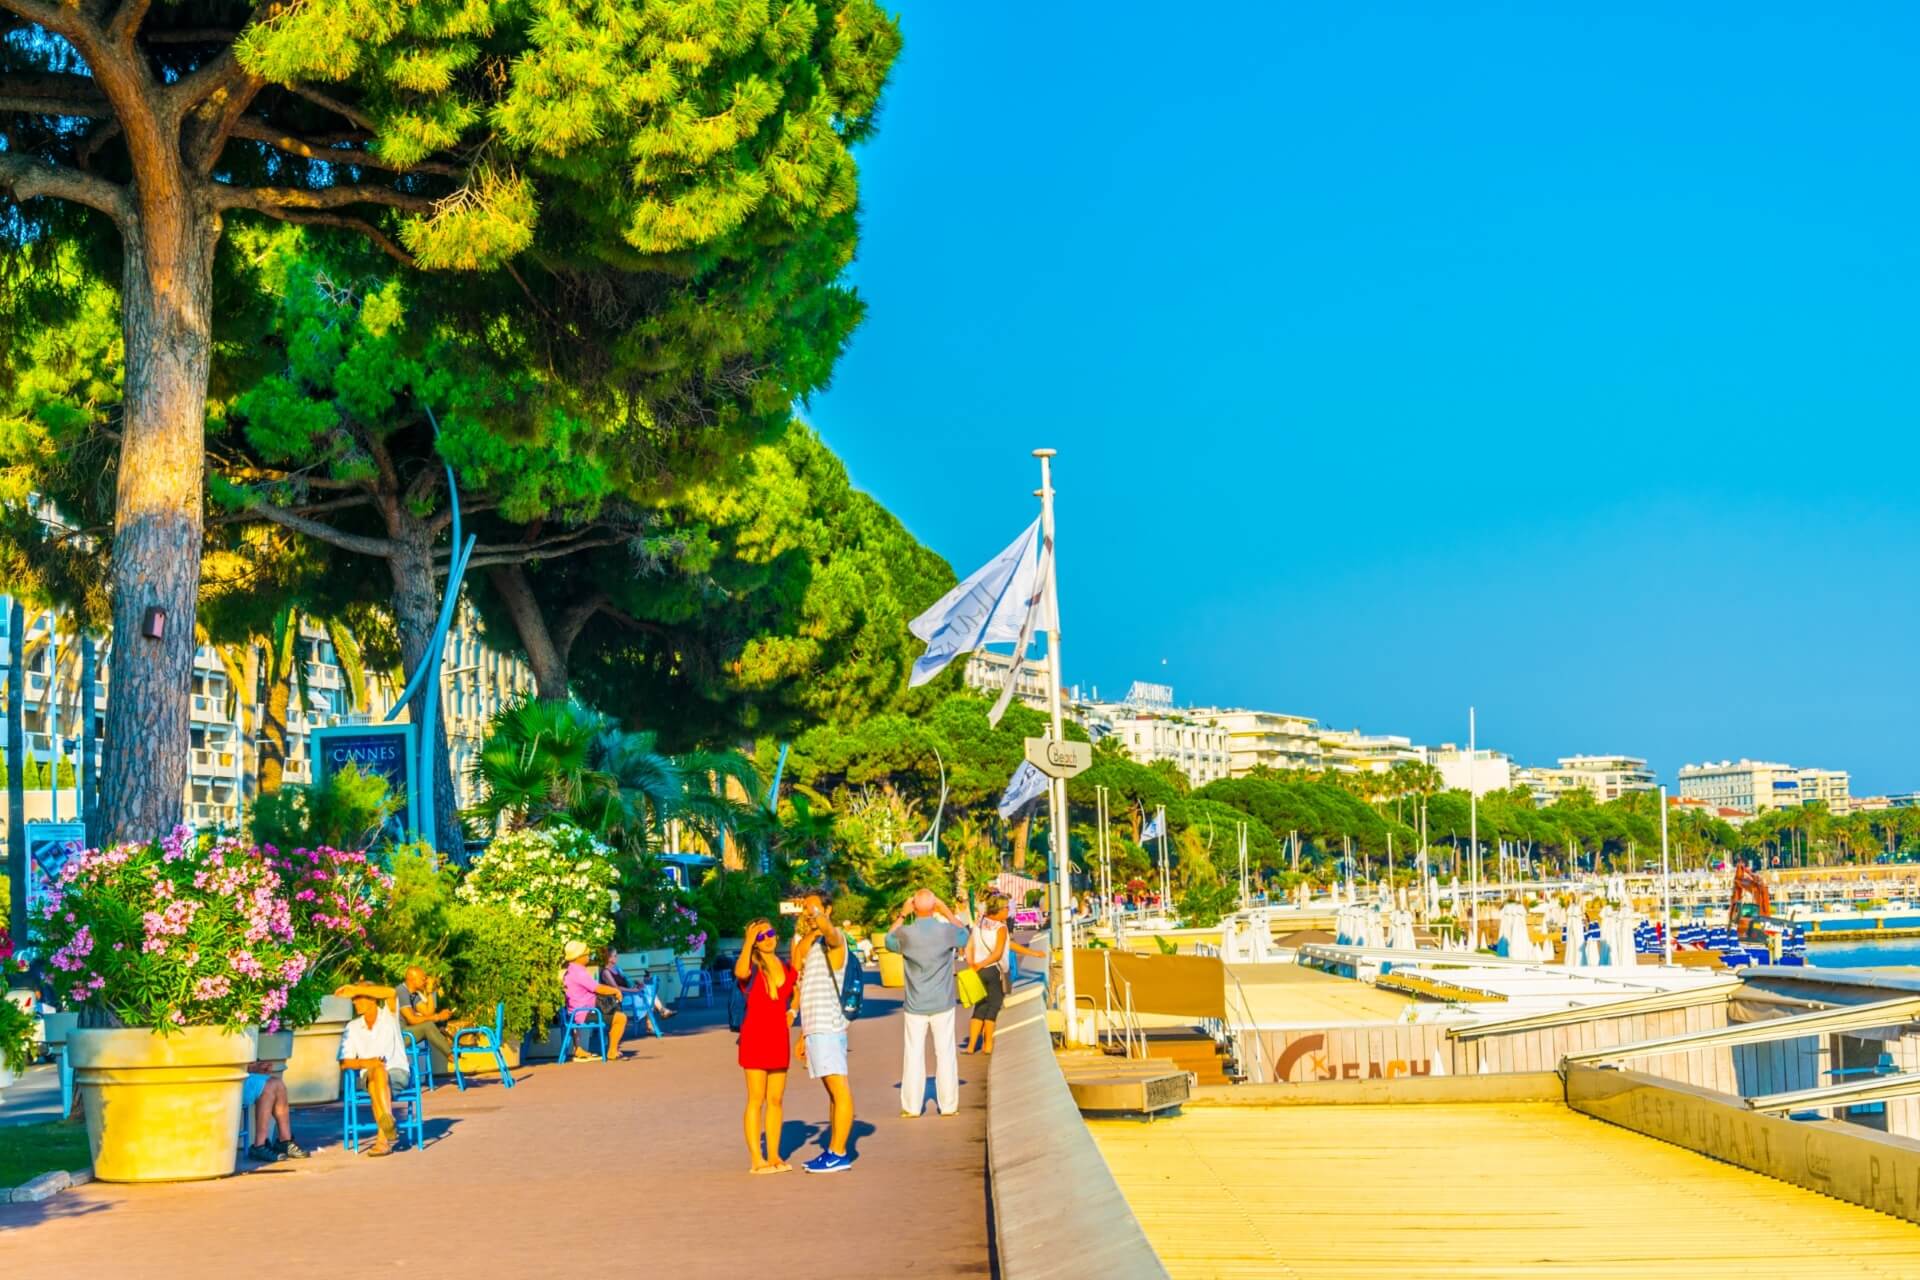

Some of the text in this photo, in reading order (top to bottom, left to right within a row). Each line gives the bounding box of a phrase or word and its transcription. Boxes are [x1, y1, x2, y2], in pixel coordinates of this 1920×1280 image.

[333, 746, 396, 762] CANNES
[1628, 1092, 1770, 1165] RESTAURANT
[1869, 1154, 1920, 1210] PL
